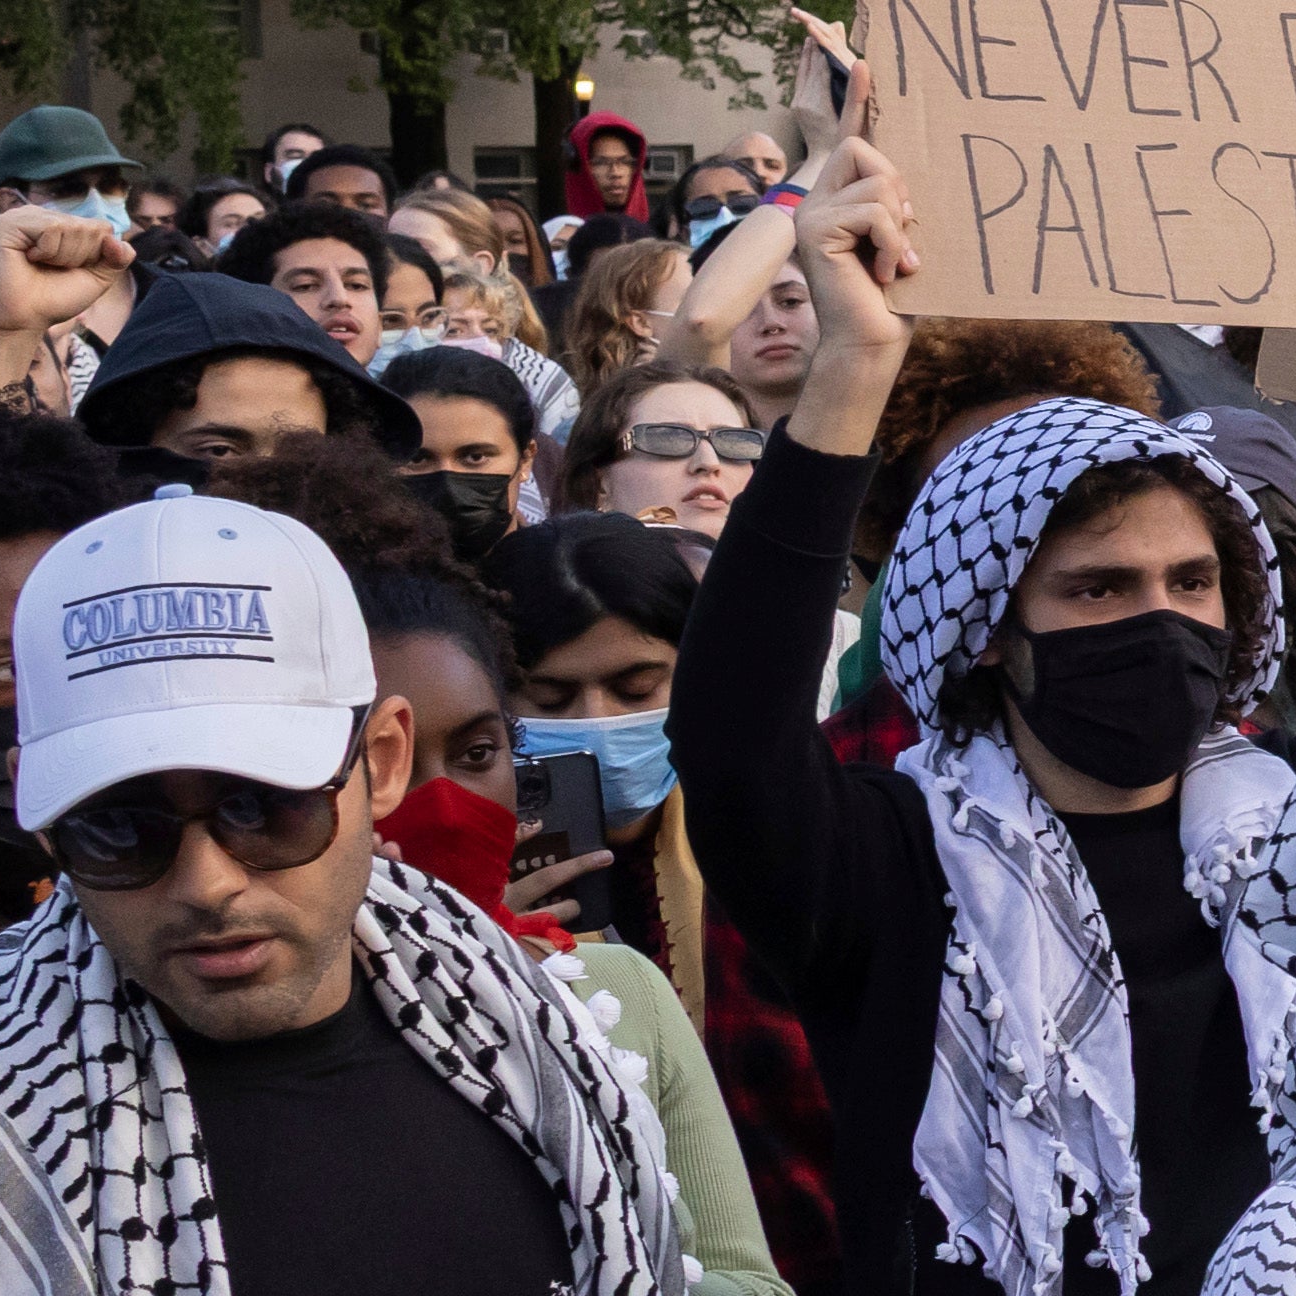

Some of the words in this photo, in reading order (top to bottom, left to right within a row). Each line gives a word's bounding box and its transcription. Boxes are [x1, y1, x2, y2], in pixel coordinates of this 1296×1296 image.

[888, 0, 1241, 122] NEVER
[63, 589, 272, 650] COLUMBIA
[98, 640, 237, 666] UNIVERSITY
